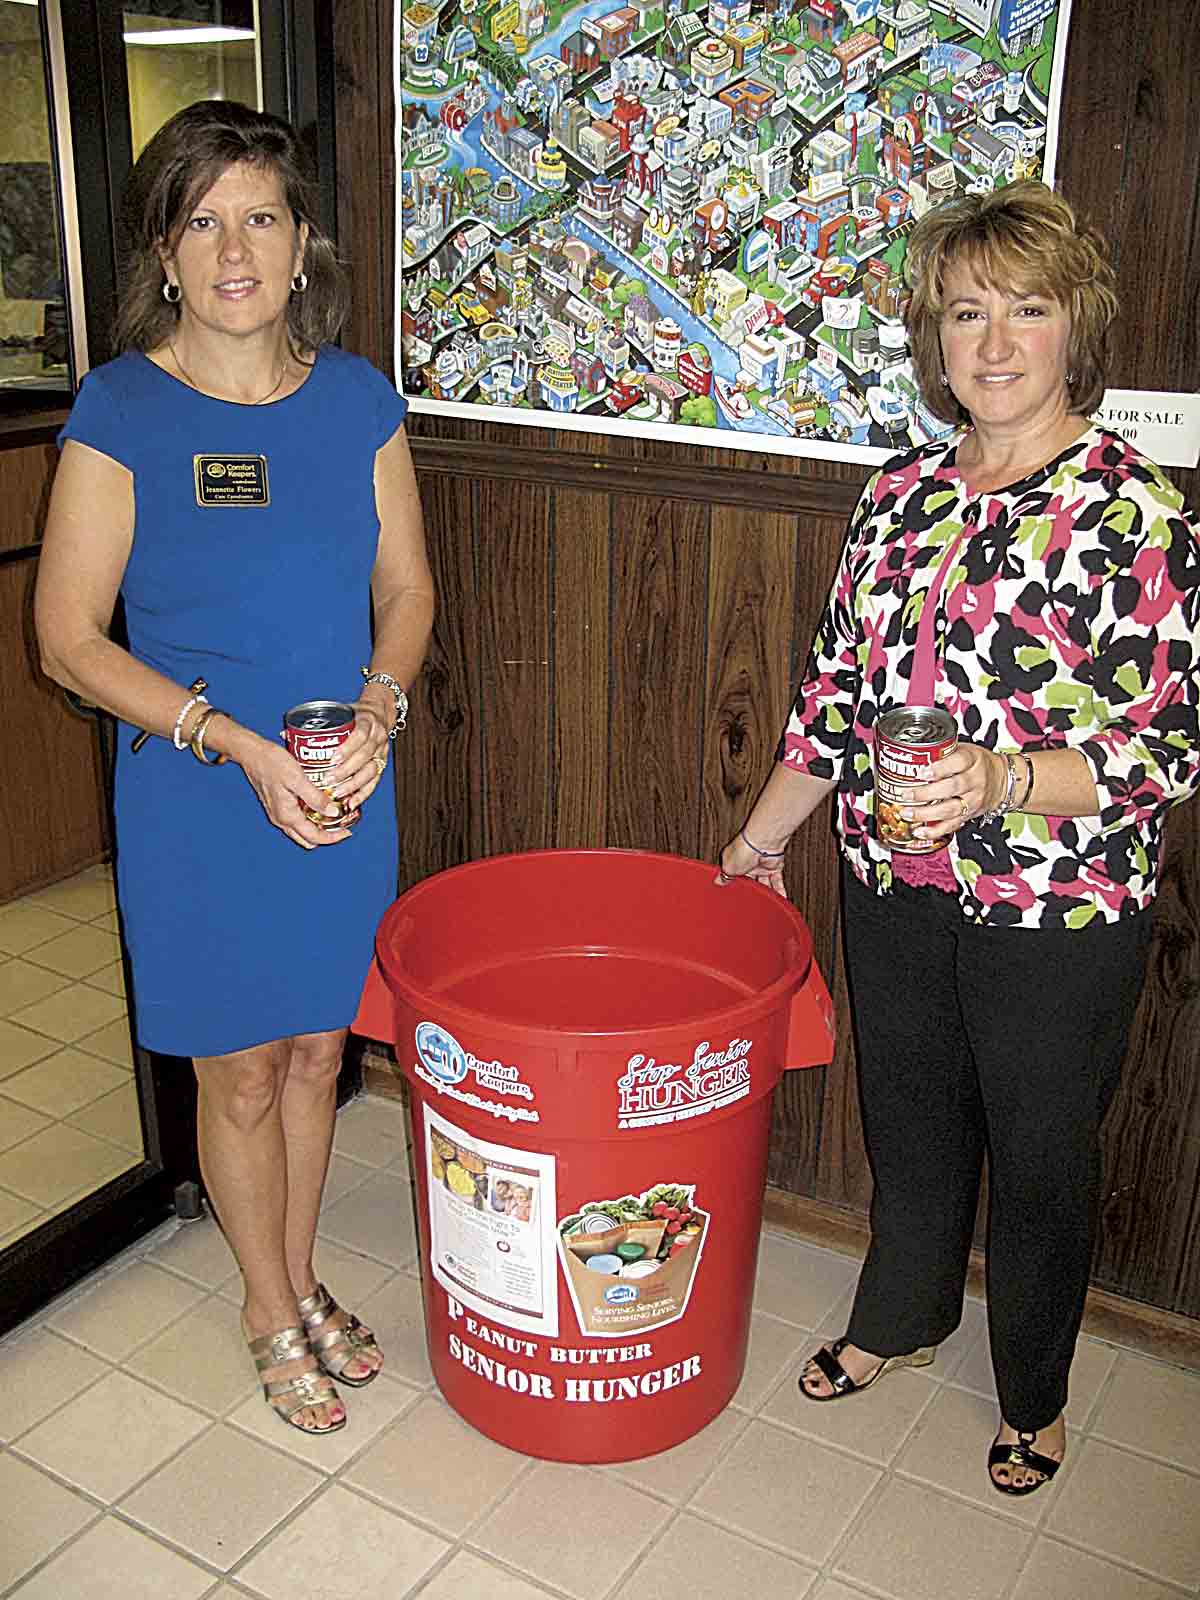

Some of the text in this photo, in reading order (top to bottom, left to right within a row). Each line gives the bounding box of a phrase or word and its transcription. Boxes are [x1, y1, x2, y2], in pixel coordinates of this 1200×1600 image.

[1109, 409, 1139, 422] FOR
[1143, 411, 1184, 425] SALE
[619, 1059, 750, 1113] HUNGER
[448, 1333, 702, 1402] SENIOR HUNGER
[550, 1343, 653, 1365] BUTTER
